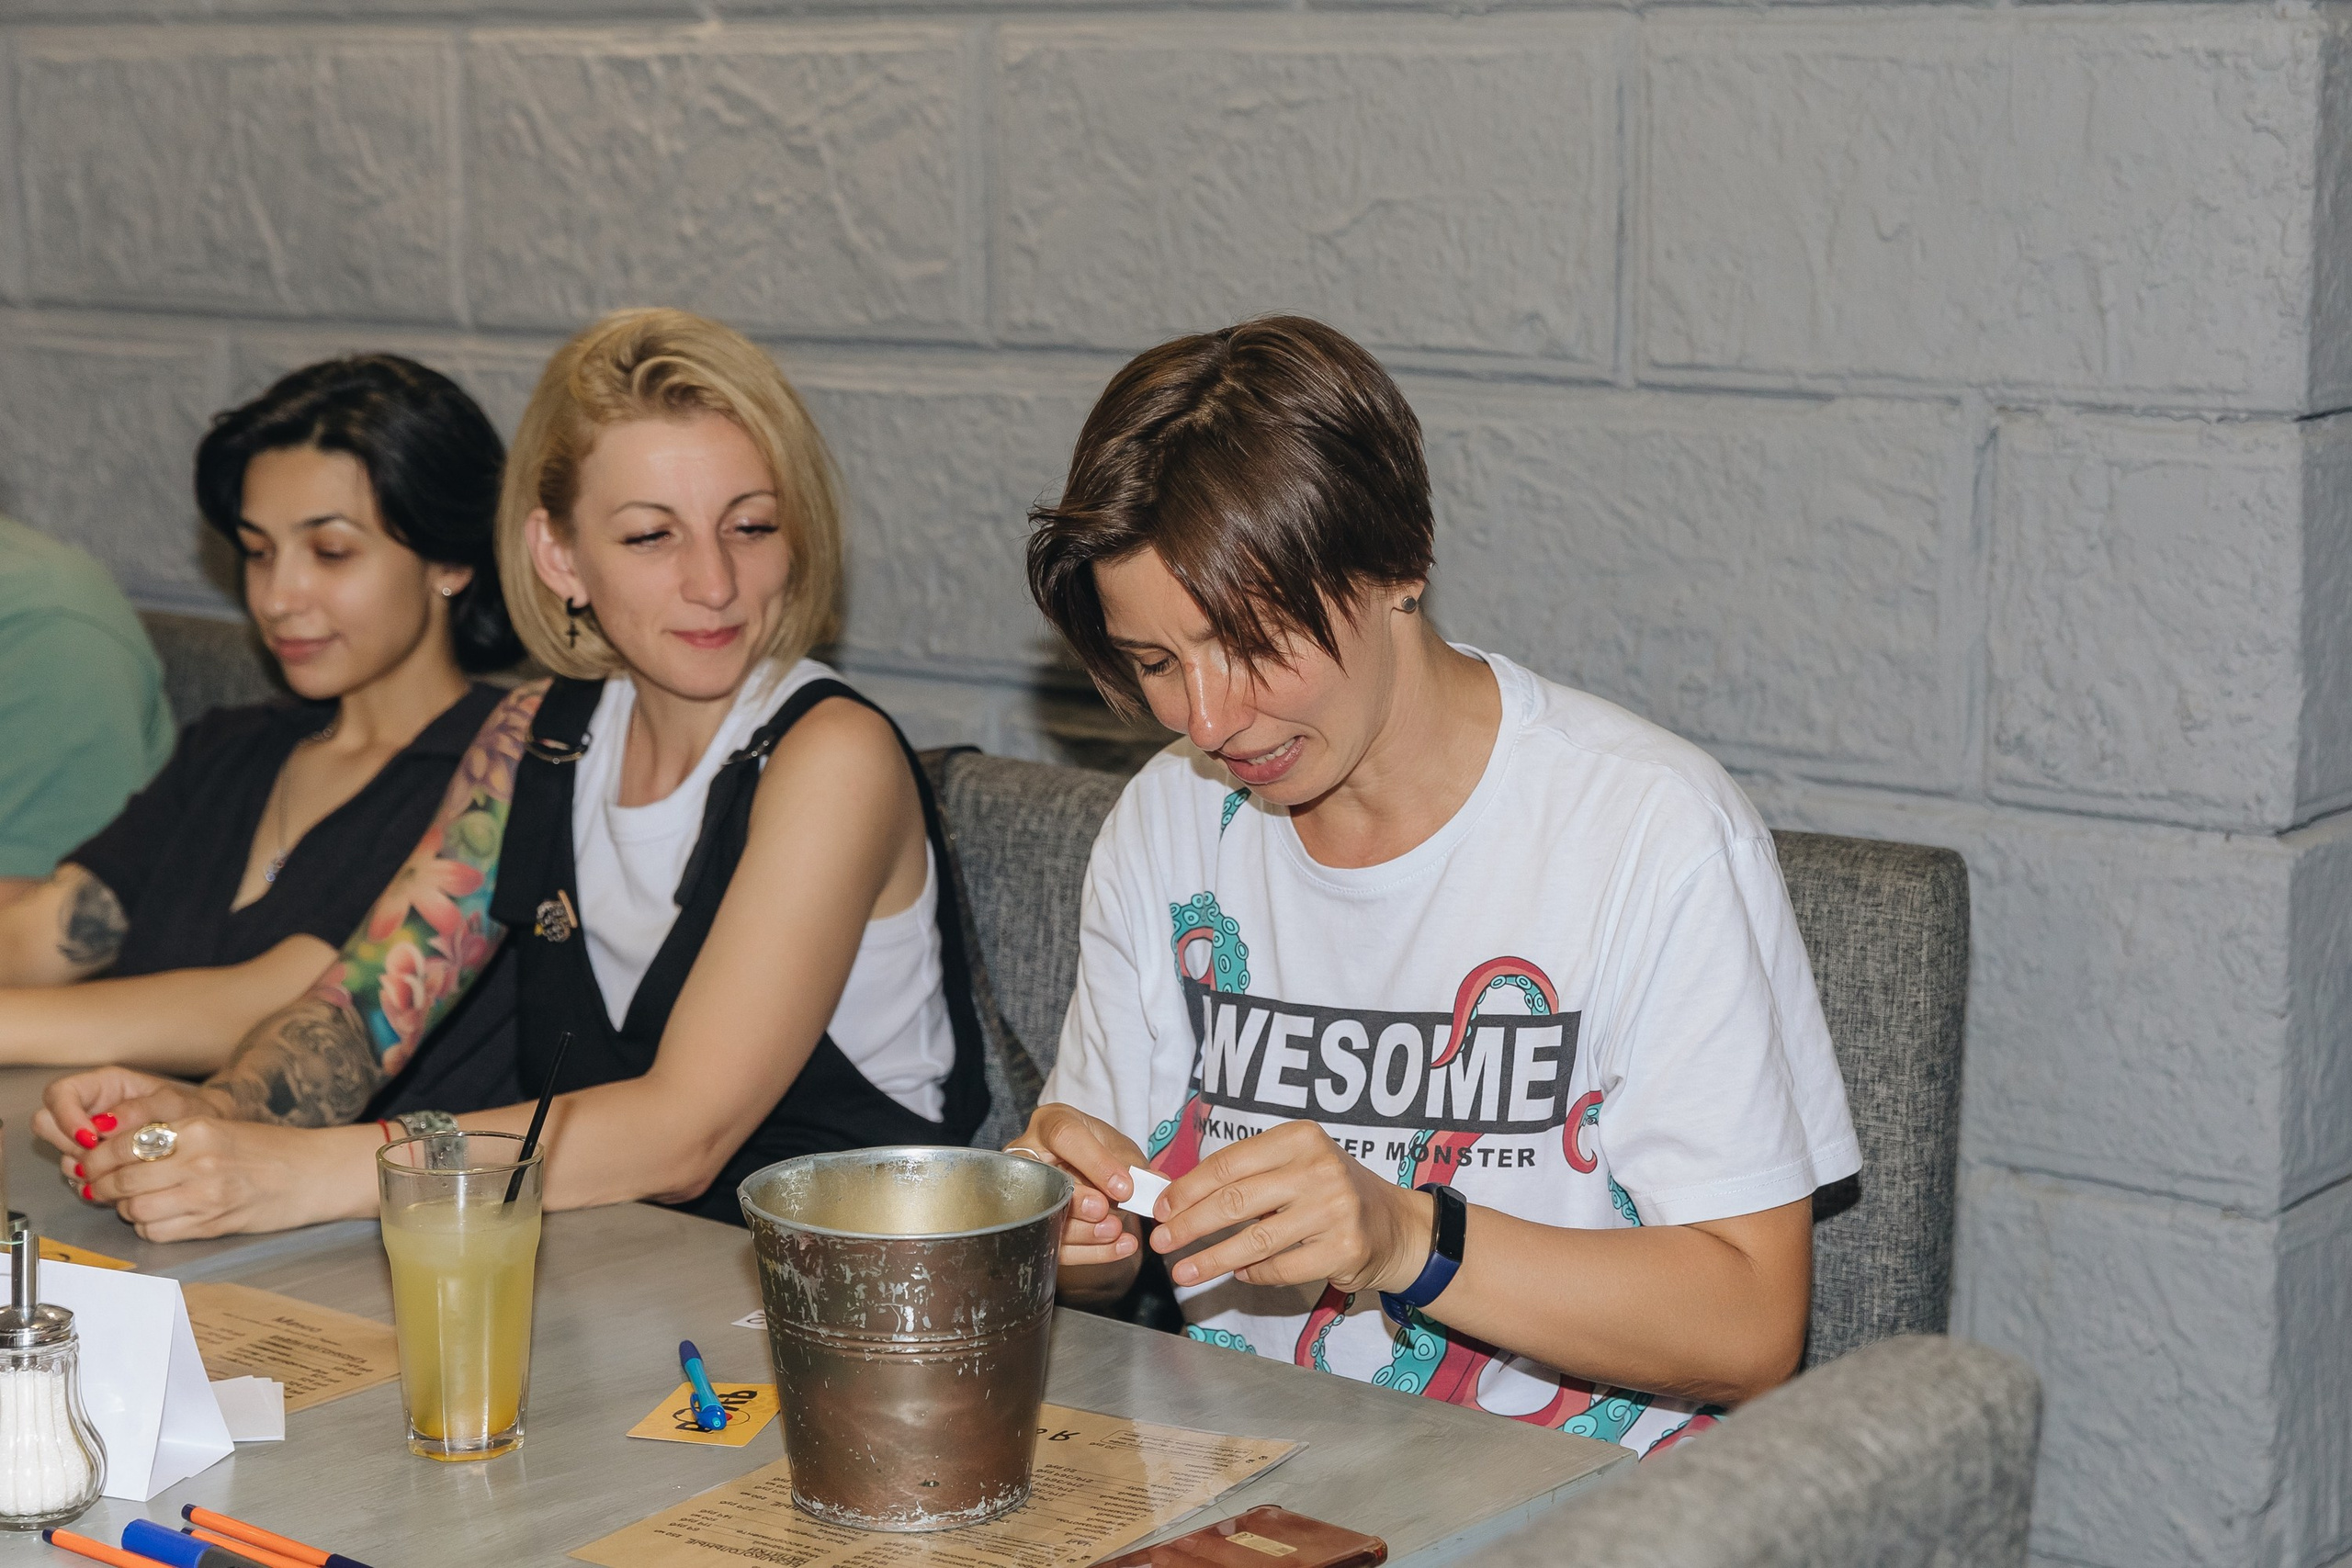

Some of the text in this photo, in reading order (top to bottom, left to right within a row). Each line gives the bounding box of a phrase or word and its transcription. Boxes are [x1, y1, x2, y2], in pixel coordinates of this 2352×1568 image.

[1193, 995, 1563, 1122] WESOME
[1332, 1137, 1375, 1159] EP
[1385, 1141, 1536, 1168] MONSTER
[1047, 1430, 1080, 1441] Я
[684, 1539, 801, 1568] БЕЗАЛКОГОЛЬНЫЕ
